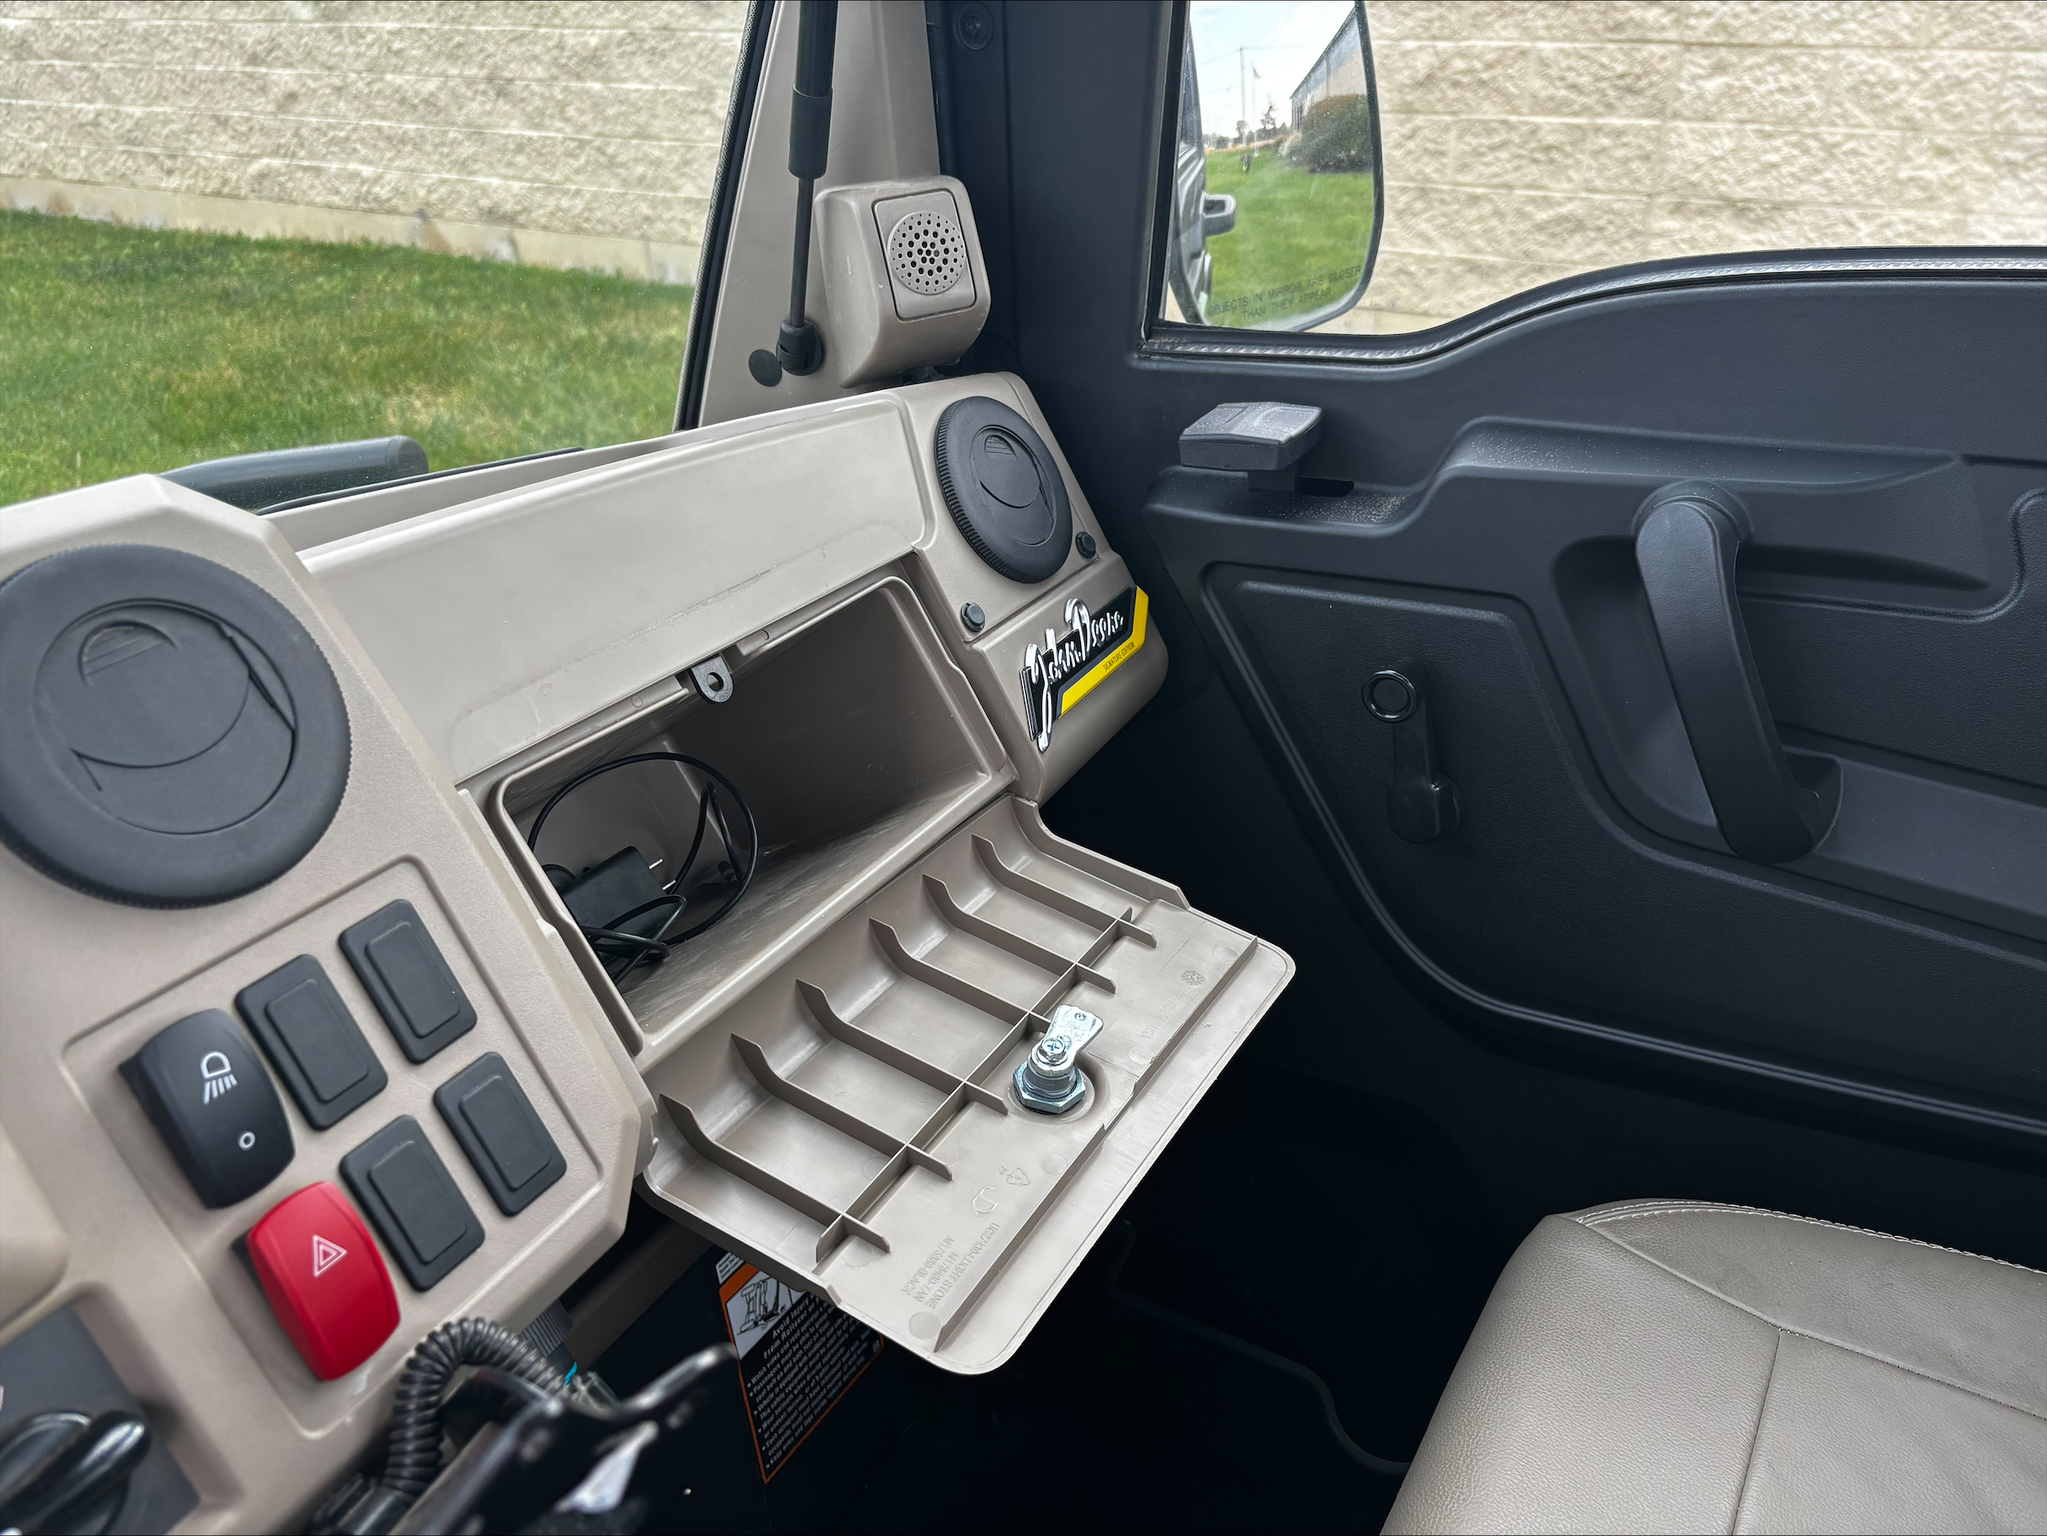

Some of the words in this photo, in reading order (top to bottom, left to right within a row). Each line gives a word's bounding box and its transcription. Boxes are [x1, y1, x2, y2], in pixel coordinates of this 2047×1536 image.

[1207, 295, 1249, 316] OBJECTS
[1253, 292, 1263, 303] IN
[1268, 281, 1301, 300] MIRROR
[1307, 275, 1324, 288] ARE
[1328, 264, 1362, 283] CLOSER
[1242, 306, 1266, 320] THAN
[1271, 298, 1294, 312] THEY
[1298, 287, 1332, 304] APPEAR
[1025, 628, 1082, 753] John
[925, 1280, 952, 1309] STONE
